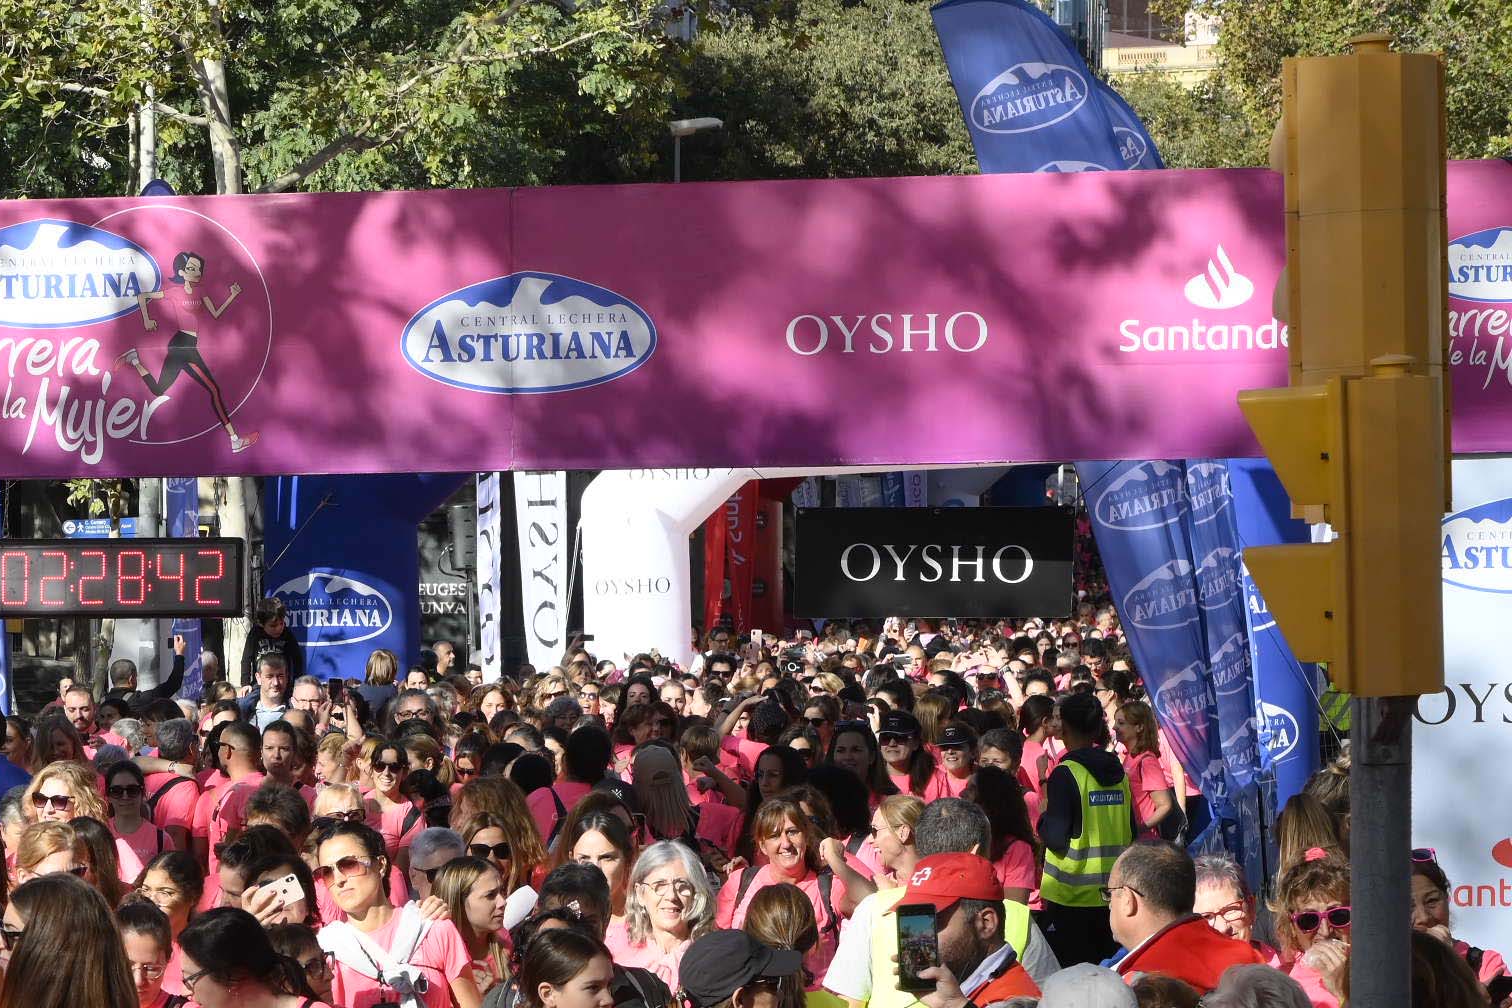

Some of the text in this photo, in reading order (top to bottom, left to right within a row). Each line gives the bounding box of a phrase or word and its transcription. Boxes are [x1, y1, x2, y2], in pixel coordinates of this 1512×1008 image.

[460, 312, 629, 327] CENTRAL LECHERA
[785, 310, 988, 357] OYSHO
[421, 320, 637, 363] ASTURIANA
[2, 381, 26, 418] la
[21, 371, 171, 465] Mujer
[0, 550, 225, 606] 02:28:42
[839, 543, 1035, 584] OYSHO
[595, 576, 671, 595] OYSHO
